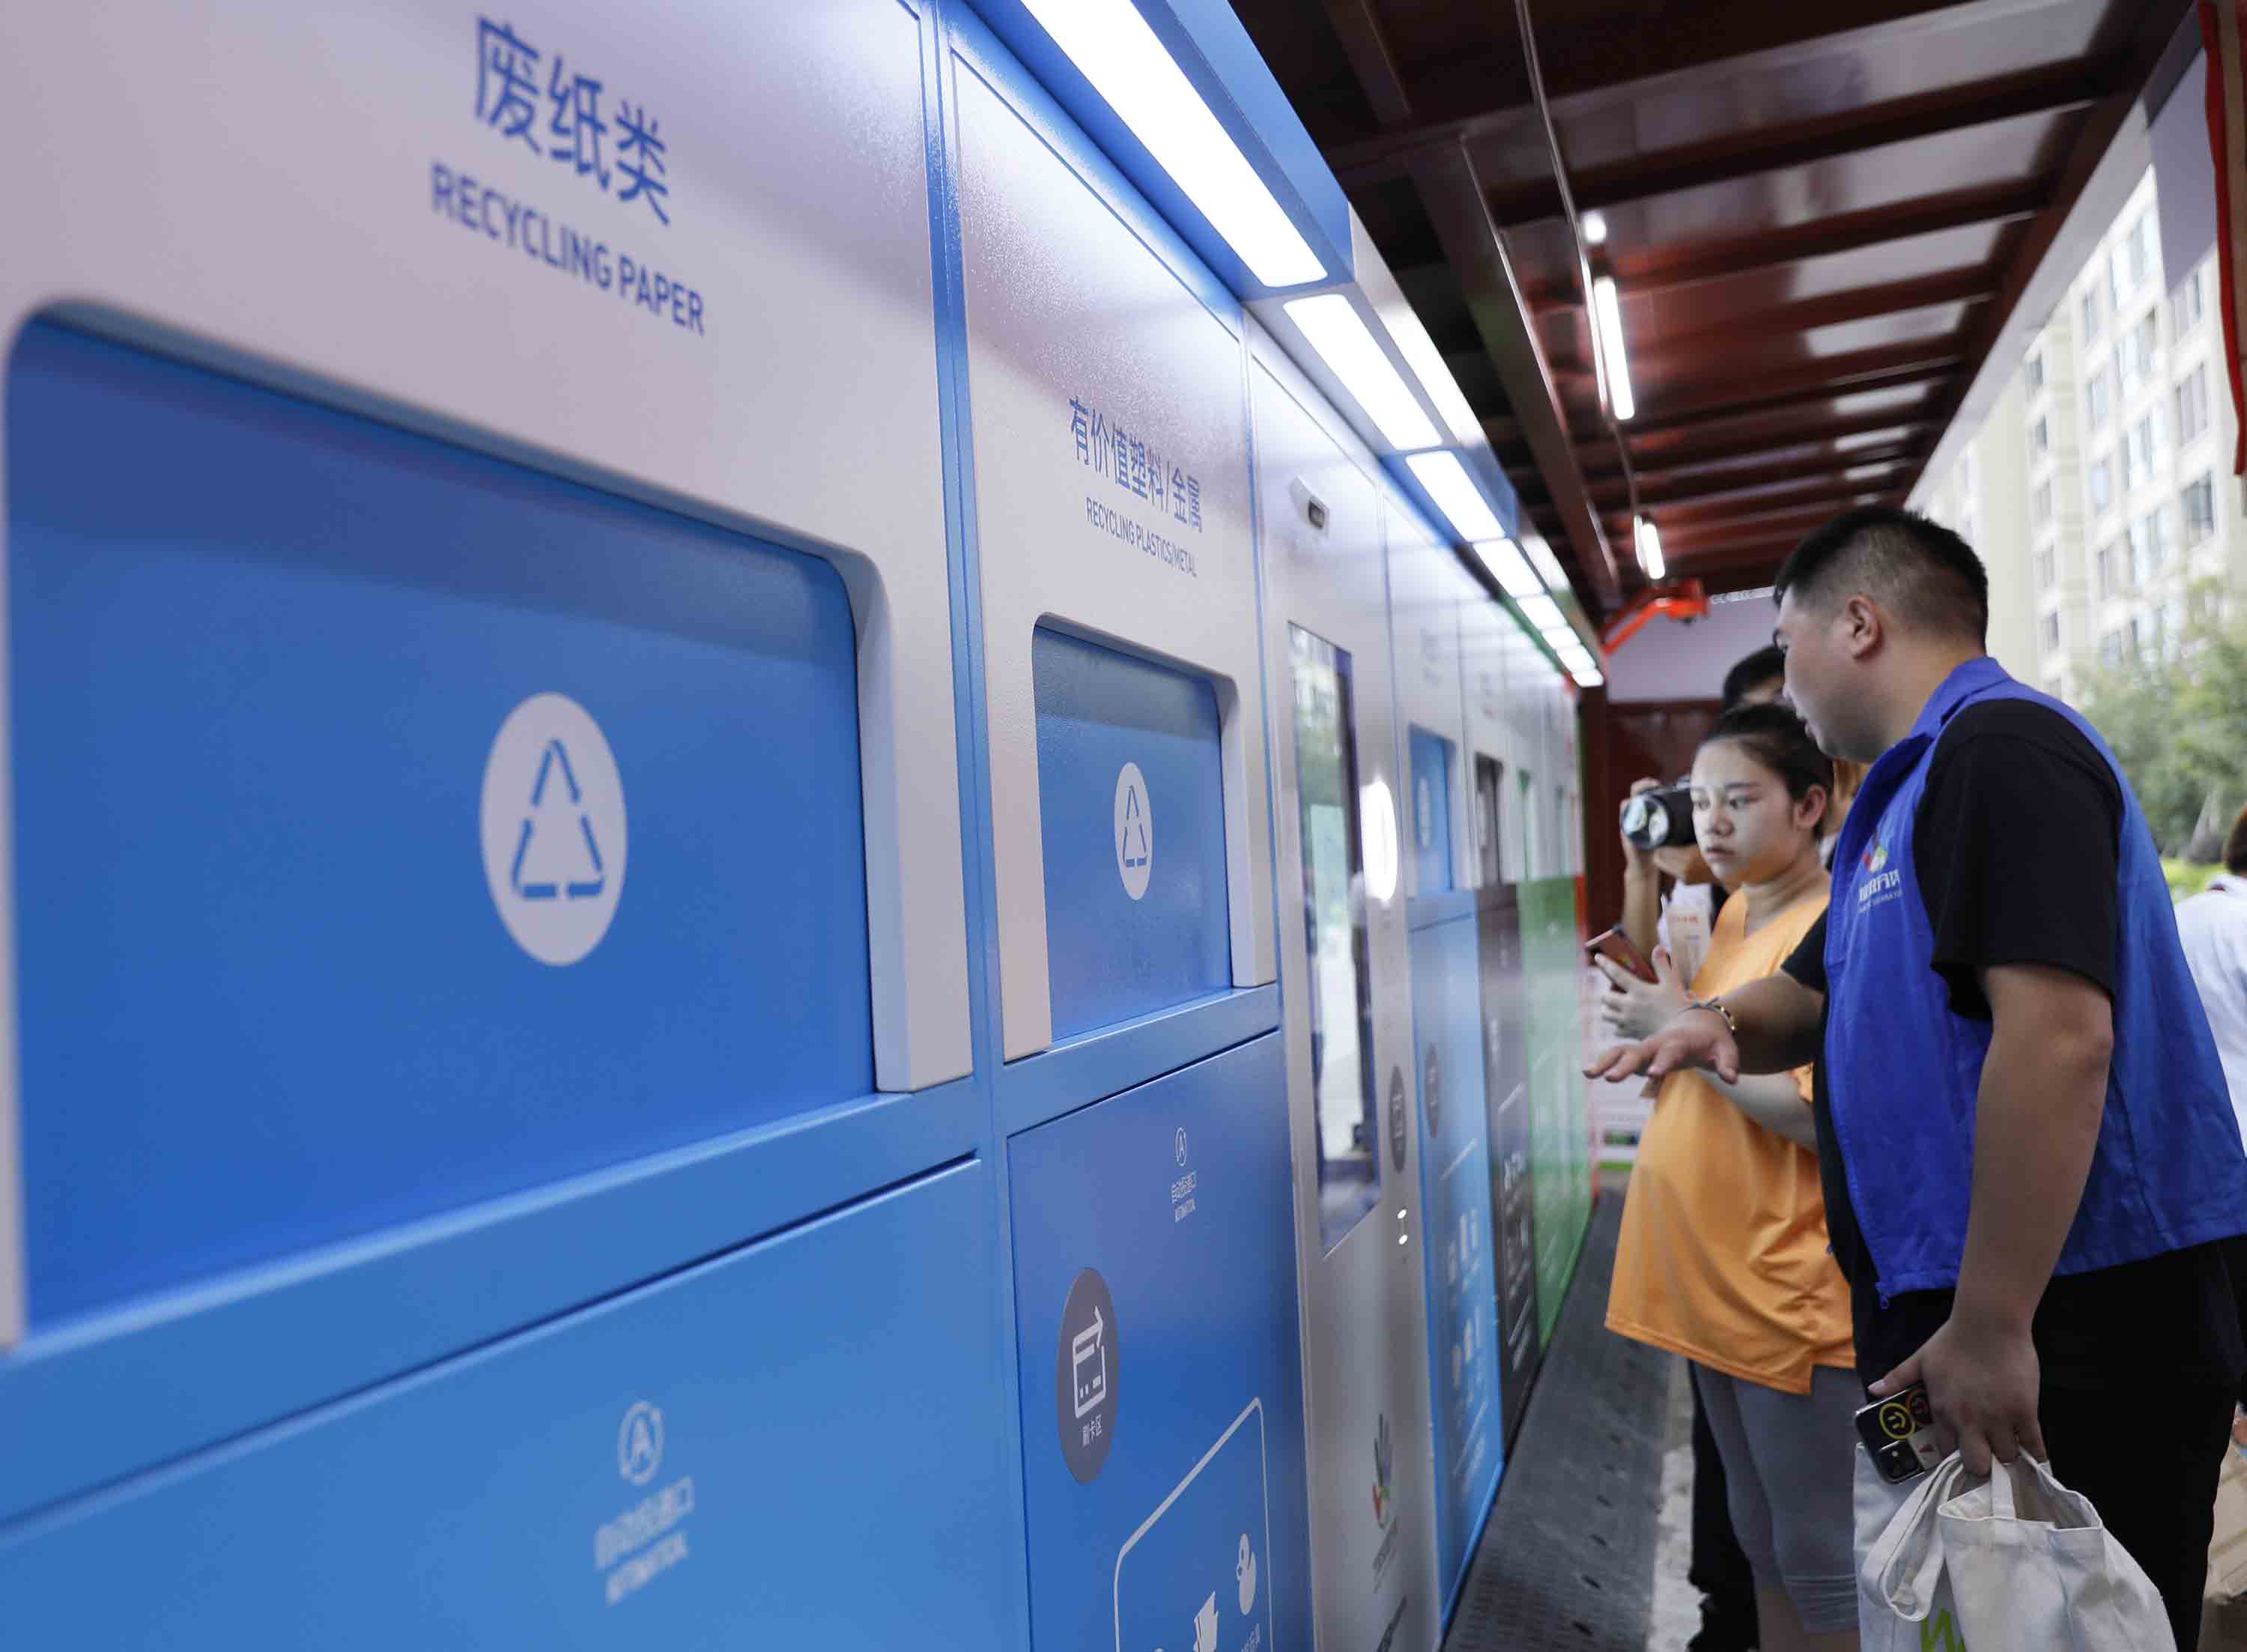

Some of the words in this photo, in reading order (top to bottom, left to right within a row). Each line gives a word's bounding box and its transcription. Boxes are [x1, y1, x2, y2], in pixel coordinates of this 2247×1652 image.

[476, 16, 670, 225] 废纸类
[431, 161, 611, 291] RECYCLING
[619, 253, 704, 336] PAPER
[1086, 496, 1135, 545] RECYCLING
